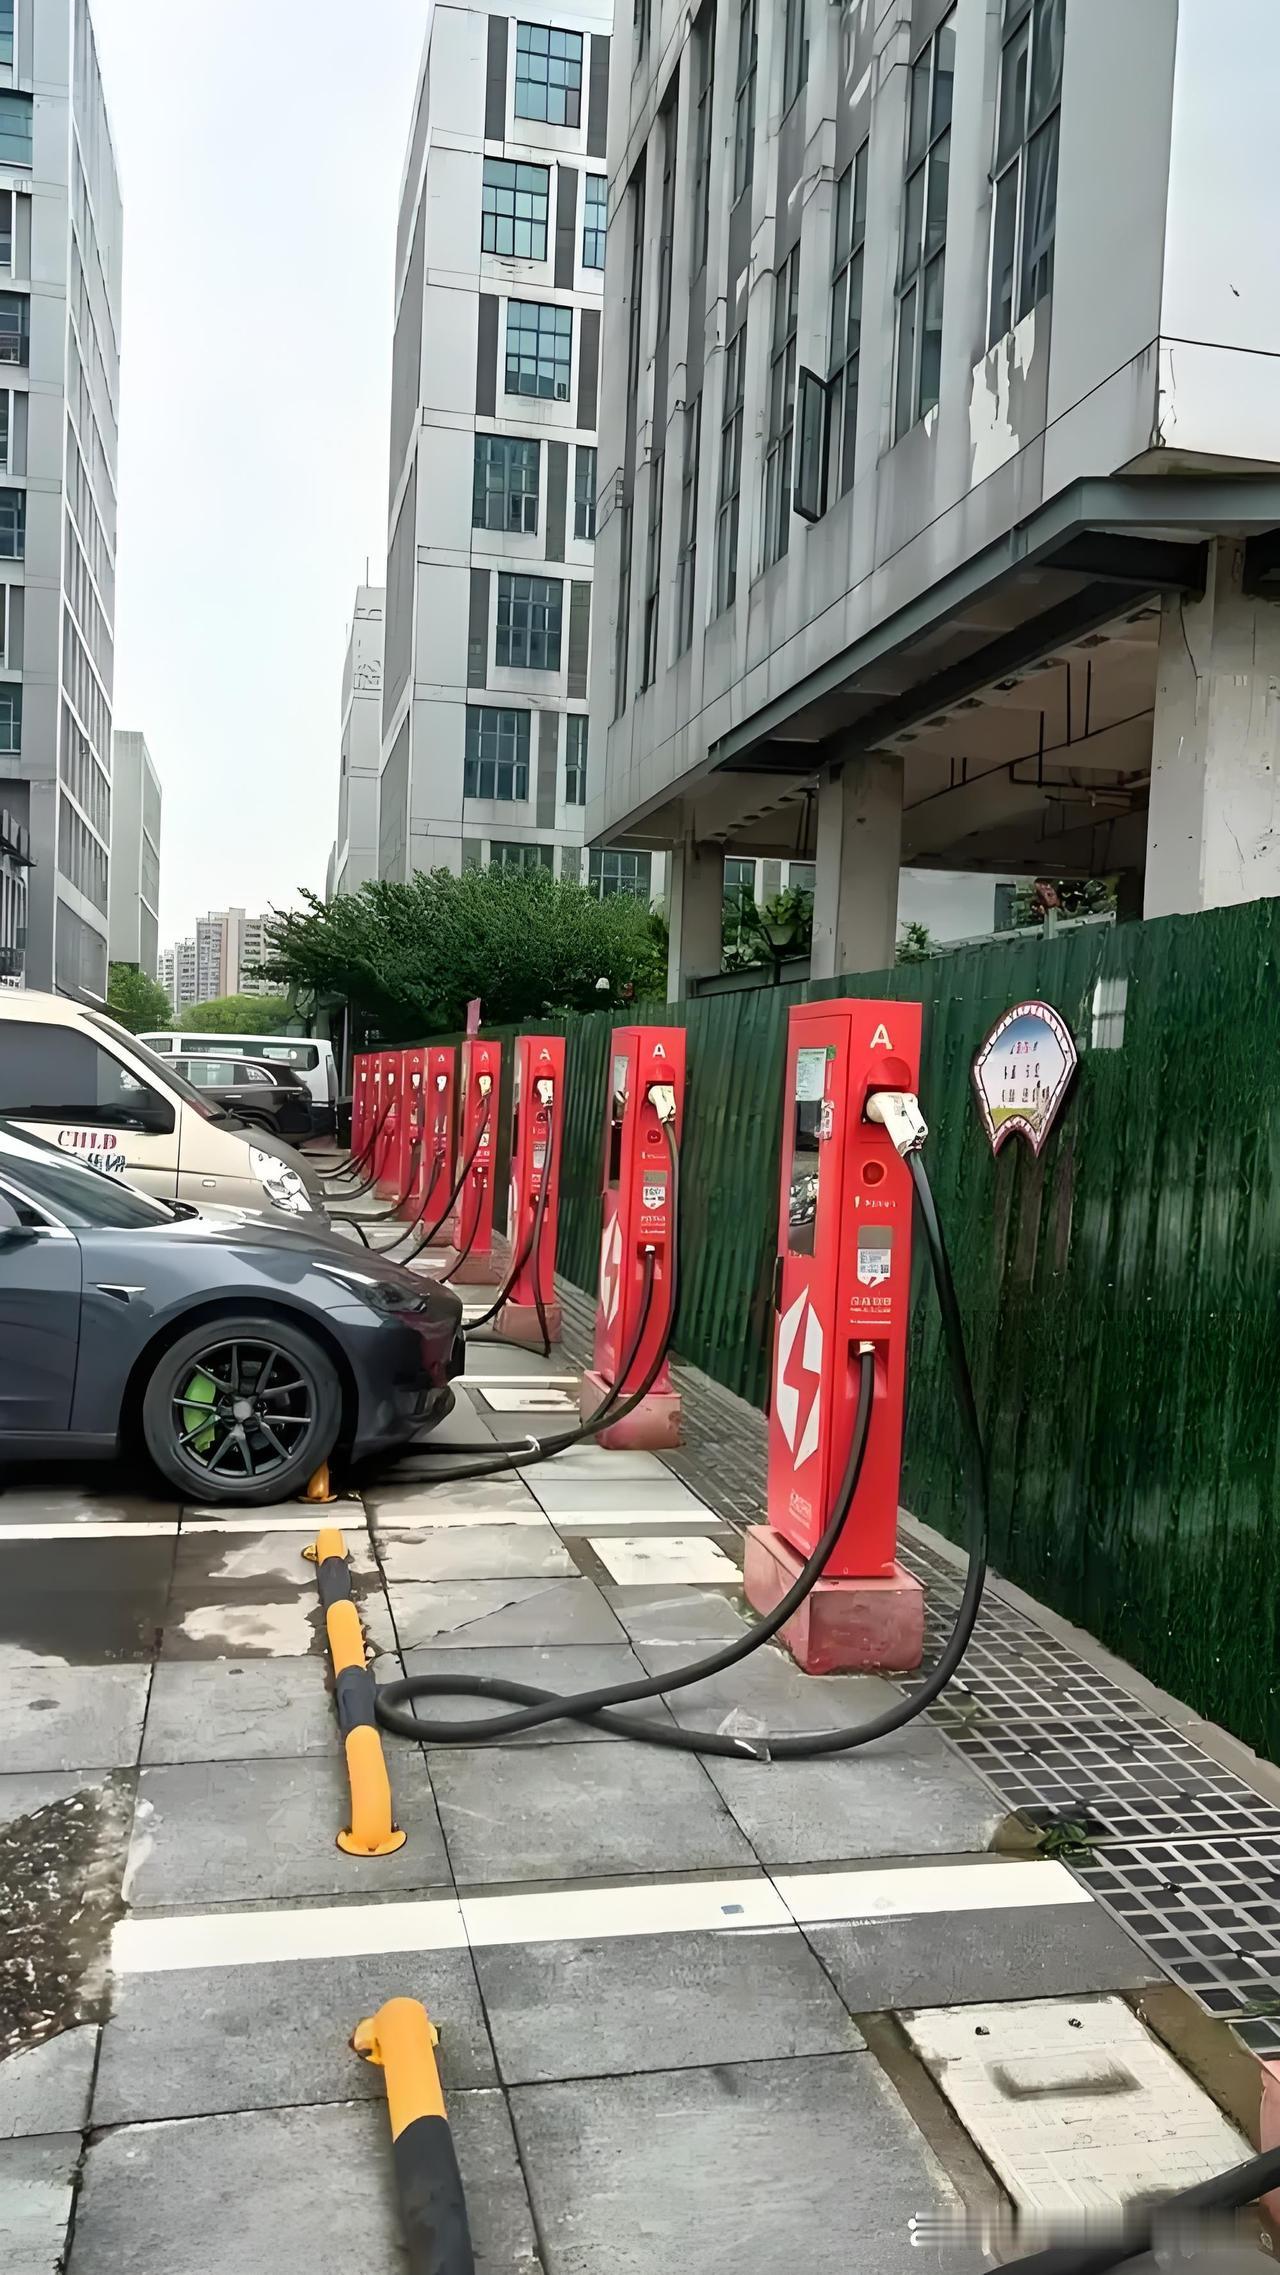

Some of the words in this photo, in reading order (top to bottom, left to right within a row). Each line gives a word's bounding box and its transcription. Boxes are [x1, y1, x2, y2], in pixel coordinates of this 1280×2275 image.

[870, 1023, 893, 1050] A
[539, 1048, 551, 1061] A
[653, 1043, 666, 1058] A
